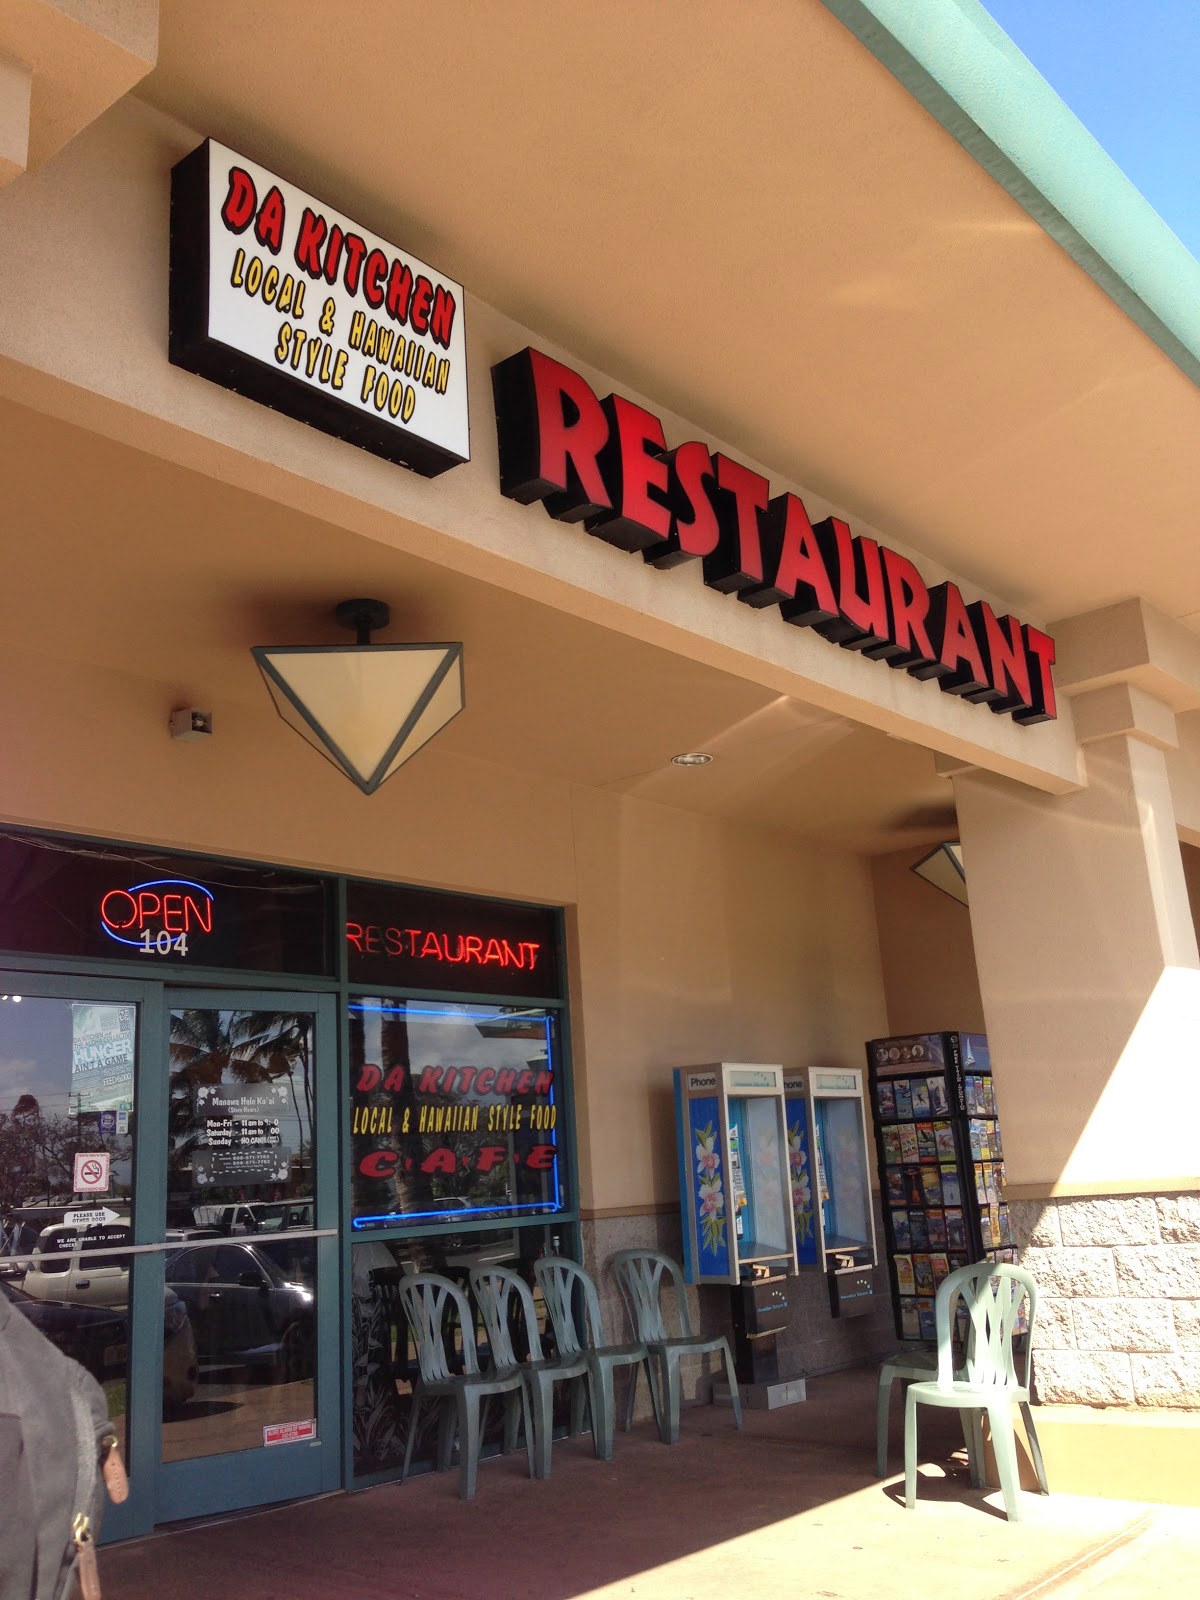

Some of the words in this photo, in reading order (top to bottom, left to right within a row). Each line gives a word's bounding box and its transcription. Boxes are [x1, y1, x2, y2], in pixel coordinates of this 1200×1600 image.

[221, 166, 285, 255] DA
[294, 207, 456, 350] KITCHEN
[231, 248, 306, 319] LOCAL
[319, 296, 336, 336] &
[349, 310, 450, 395] HAWAIIAN
[274, 322, 348, 390] STYLE
[361, 365, 415, 424] FOOD
[528, 345, 1057, 721] RESTAURANT
[101, 890, 212, 932] OPEN
[140, 929, 189, 956] 104
[346, 922, 540, 970] RESTAURANT
[82, 1032, 104, 1042] KITCHEN
[103, 1032, 132, 1043] COLLECTIVE
[73, 1038, 132, 1064] HUNGER
[97, 1059, 103, 1067] A
[105, 1054, 128, 1065] GAME
[356, 1064, 405, 1093] DA
[419, 1065, 554, 1097] KITCHEN
[690, 1076, 716, 1087] Phone
[784, 1080, 803, 1089] hone
[212, 1097, 239, 1106] Manawa
[241, 1097, 256, 1106] Hale
[206, 1119, 232, 1127] Mon-Fri
[353, 1106, 392, 1135] LOCAL
[401, 1111, 410, 1134] &
[419, 1104, 478, 1132] HAWAIIAN
[488, 1103, 523, 1131] STYLE
[529, 1104, 557, 1130] FOOD
[206, 1129, 232, 1137] Saturday
[208, 1138, 232, 1146] Sunday
